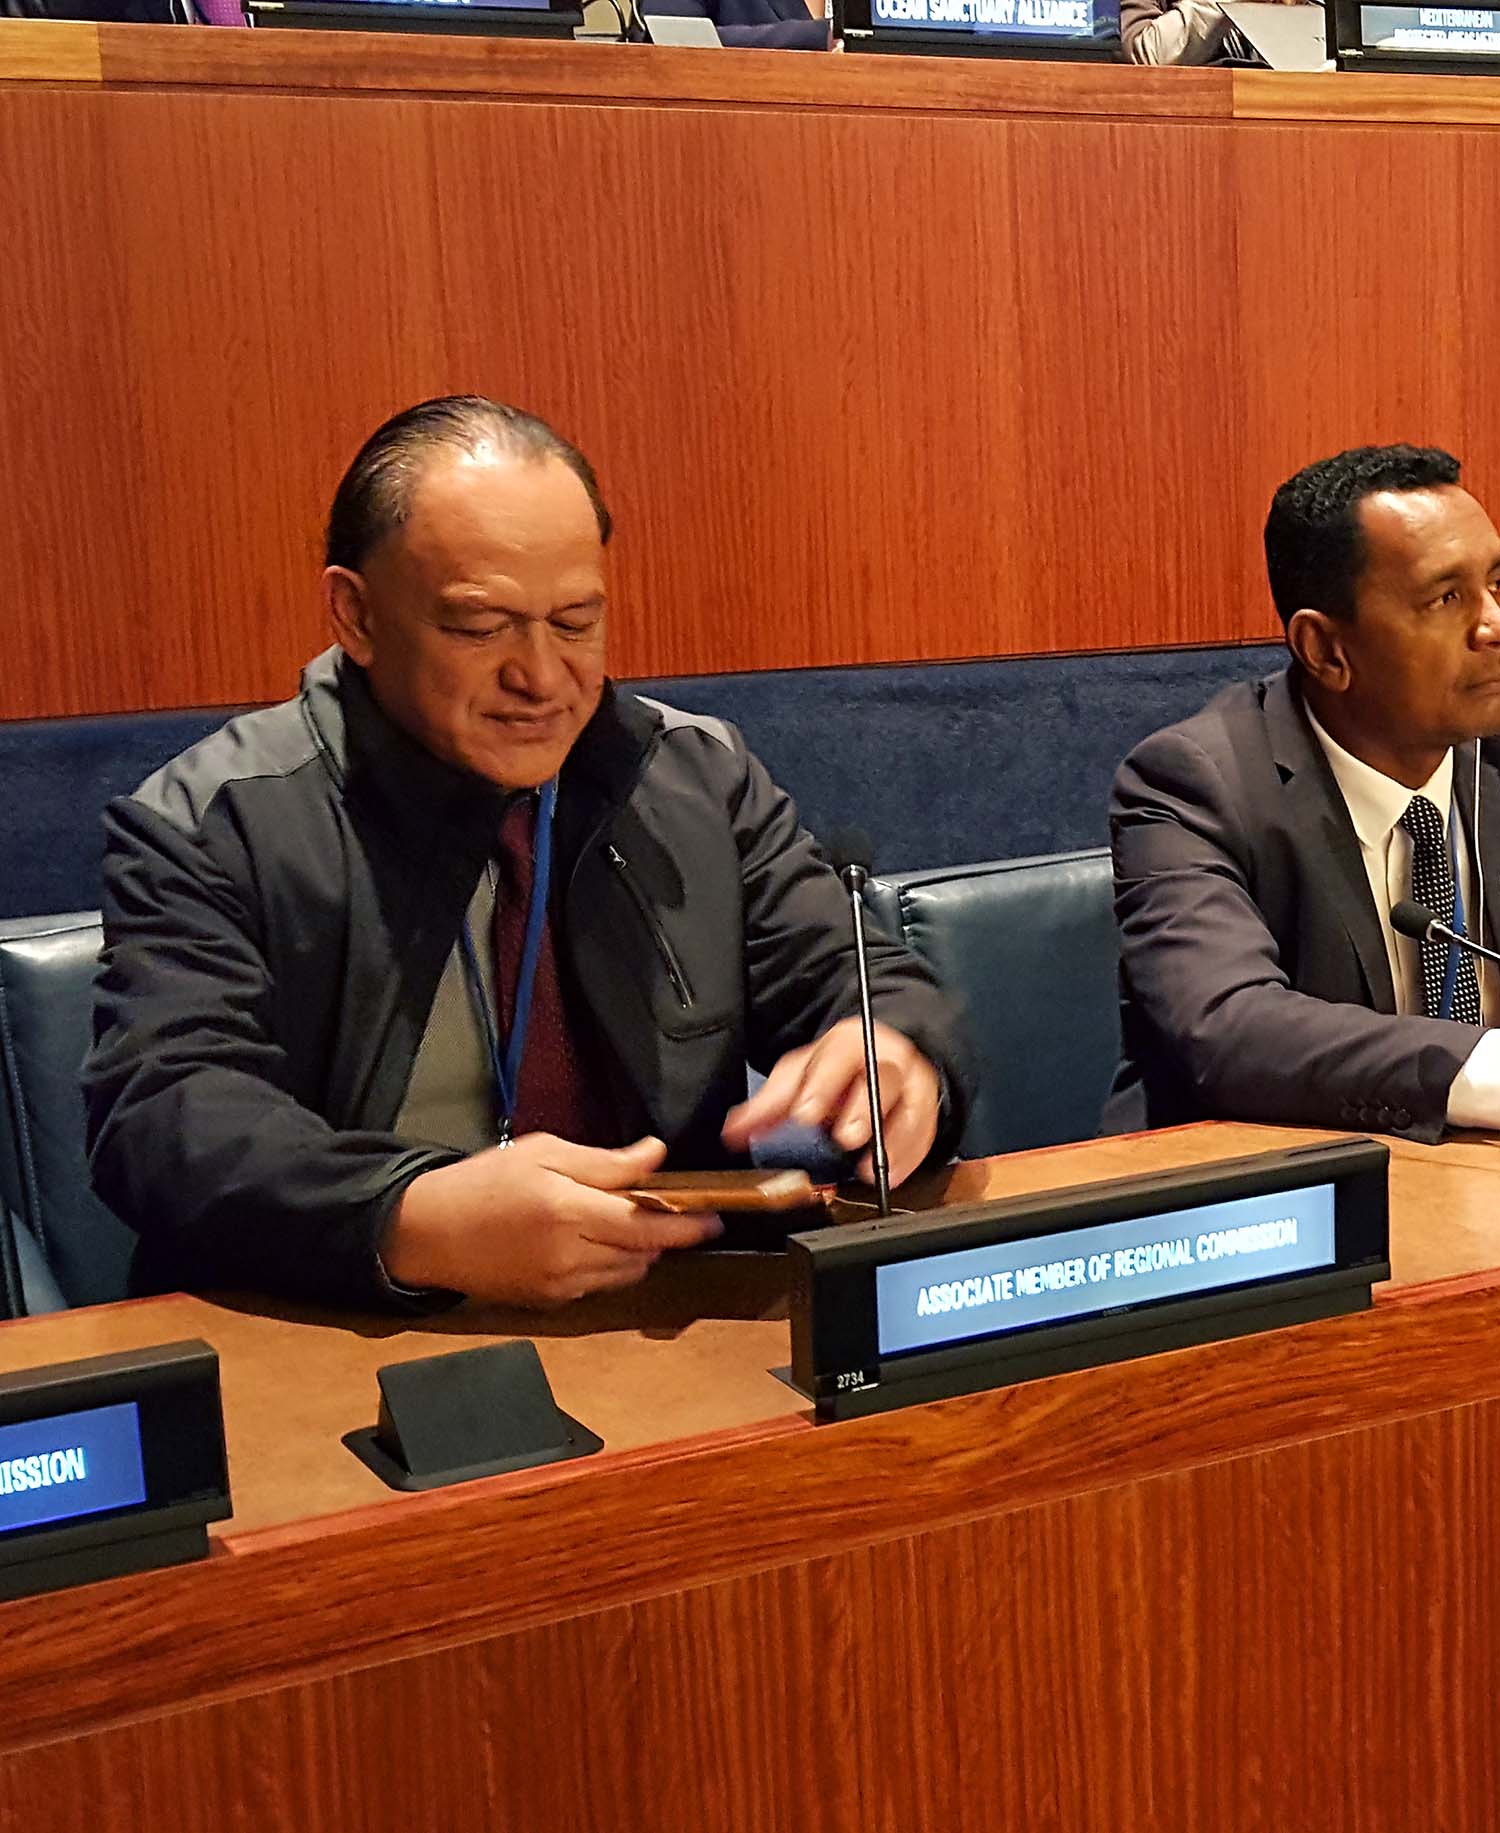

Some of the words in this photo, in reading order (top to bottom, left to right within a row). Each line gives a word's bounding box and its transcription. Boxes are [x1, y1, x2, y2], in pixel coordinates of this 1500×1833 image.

[876, 0, 927, 20] OCEAN
[929, 0, 1015, 24] SANCTUARY
[1017, 0, 1089, 27] ALLIANCE
[917, 1271, 1014, 1317] ASSOCIATE
[1015, 1257, 1087, 1296] MEMBER
[1088, 1253, 1111, 1283] OF
[1114, 1238, 1195, 1278] REGIONAL
[1196, 1217, 1298, 1261] COMMISSION
[836, 1370, 864, 1389] 2734
